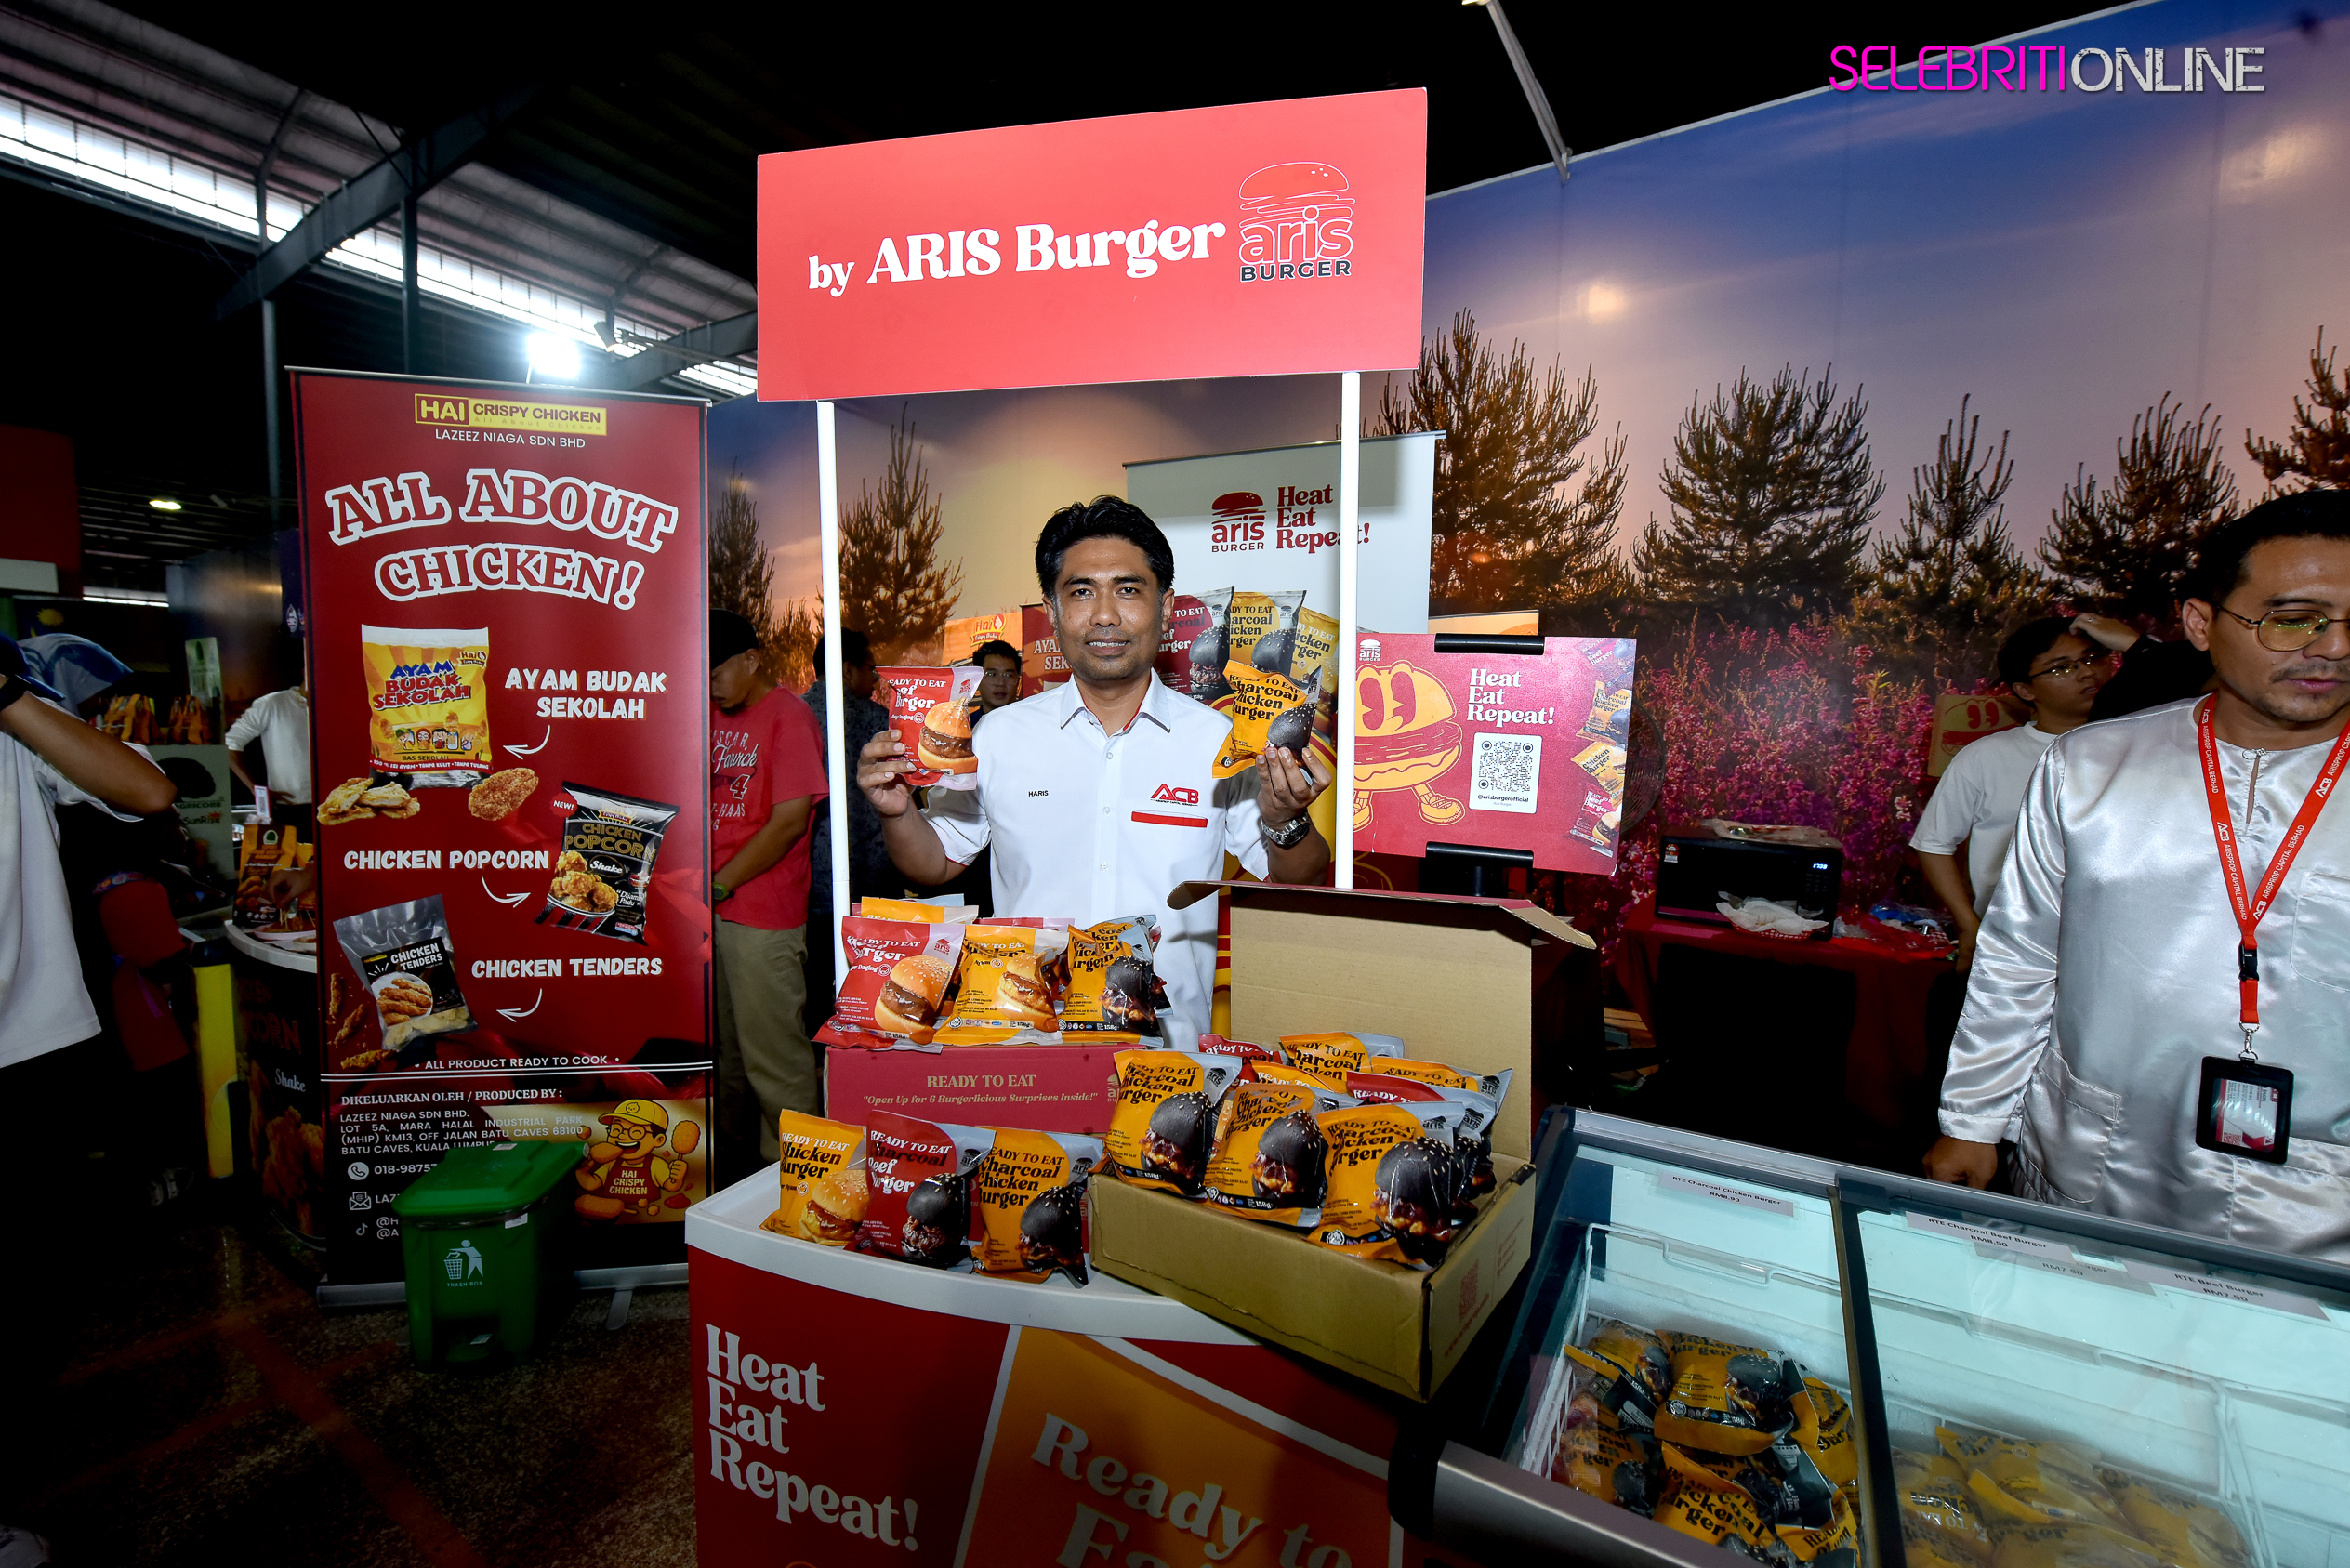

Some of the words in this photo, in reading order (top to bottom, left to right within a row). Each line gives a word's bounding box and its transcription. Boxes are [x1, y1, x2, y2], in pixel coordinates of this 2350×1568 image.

[1238, 205, 1353, 265] aris
[808, 255, 854, 296] by
[865, 228, 1001, 284] ARIS
[1015, 219, 1226, 279] Burger
[1239, 259, 1353, 283] BURGER
[420, 400, 465, 421] HAI
[472, 403, 529, 418] CRISPY
[532, 407, 601, 424] CHICKEN
[435, 428, 480, 442] LAZEEZ
[483, 432, 525, 445] NIAGA
[529, 435, 556, 447] SDN
[560, 438, 586, 448] BHD
[1277, 484, 1333, 507] Heat
[325, 471, 452, 546] ALL
[459, 468, 679, 554] ABOUT
[1277, 507, 1316, 528] Eat
[1212, 515, 1264, 543] aris
[1276, 523, 1370, 554] Repet!
[1212, 542, 1264, 552] BURGER
[375, 543, 645, 611] CHICKEN!
[1189, 607, 1205, 616] EAT
[1034, 639, 1061, 654] AYA
[389, 659, 455, 679] AYAM
[1470, 668, 1521, 687] Heat
[385, 673, 461, 693] BUDAK
[505, 668, 578, 691] AYAM
[587, 671, 667, 693] BUDAK
[1265, 677, 1279, 686] TO
[1281, 680, 1300, 693] EAT
[372, 685, 471, 711] SEKOLAH
[1469, 685, 1505, 705] Eat
[536, 697, 645, 720] SEKOLAH
[1467, 704, 1555, 727] Repeat!
[730, 774, 750, 799] 4
[1028, 789, 1049, 797] HARIS
[1150, 783, 1199, 804] ACB
[2315, 777, 2333, 798] ACB
[553, 800, 574, 810] NEW!
[582, 824, 642, 841] CHICKEN
[2217, 822, 2230, 842] ACB
[564, 834, 656, 863] POPCORN
[2224, 843, 2237, 874] ARISPROP
[344, 850, 441, 869] CHICKEN
[449, 850, 549, 869] POPCORN
[589, 860, 622, 874] Shake
[2252, 900, 2267, 920] ACB
[2262, 871, 2280, 899] ARISPROP
[2276, 848, 2292, 871] CAPITAL
[2288, 824, 2305, 849] BERHAD
[2230, 872, 2242, 899] CAPITAL
[390, 942, 440, 965] CHICKEN
[400, 953, 442, 971] TENDERS
[471, 958, 561, 978] CHICKEN
[569, 957, 662, 976] TENDERS
[425, 1060, 444, 1070] ALL
[448, 1058, 506, 1069] PRODUCT
[510, 1057, 548, 1068] READY
[552, 1057, 569, 1065] TO
[572, 1055, 607, 1064] COOK
[1343, 1050, 1365, 1061] EAT
[927, 1074, 979, 1087] READY
[982, 1075, 1004, 1087] TO
[1008, 1074, 1036, 1087] EAT
[341, 1092, 429, 1105] DIKELUARKAN
[432, 1091, 464, 1101] OLEH
[475, 1088, 538, 1100] PRODUCED
[540, 1088, 557, 1099] BY
[863, 1095, 894, 1105] "Open
[896, 1095, 909, 1106] Up
[911, 1095, 927, 1103] for
[930, 1095, 935, 1103] 6
[937, 1094, 1007, 1104] Burgerlicious
[1009, 1093, 1058, 1103] Surprises
[1060, 1092, 1098, 1102] Inside!"
[340, 1113, 377, 1123] LAZEEZ
[381, 1111, 416, 1120] NIAGA
[419, 1110, 441, 1119] SDN
[444, 1110, 469, 1118] BHD.
[340, 1125, 360, 1133] LOT
[372, 1123, 389, 1132] 5A,
[400, 1122, 431, 1131] MARA
[442, 1120, 474, 1128] HALAL
[485, 1117, 546, 1127] INDUSTRIAL
[555, 1116, 583, 1125] PARK
[341, 1133, 379, 1145] (MHIP)
[385, 1133, 415, 1142] KM13,
[418, 1132, 439, 1140] OFF
[443, 1130, 477, 1140] JALAN
[482, 1129, 509, 1139] BATU
[513, 1127, 548, 1137] CAVES
[552, 1127, 584, 1135] 68100
[782, 1133, 813, 1147] READY
[814, 1139, 827, 1147] TO
[829, 1141, 850, 1152] EAT
[871, 1130, 909, 1147] READY
[928, 1144, 953, 1154] EAT
[341, 1146, 370, 1154] BATU
[374, 1144, 413, 1153] CAVES,
[416, 1142, 450, 1152] KUALA
[868, 1158, 897, 1174] Beef
[981, 1155, 1061, 1179] Charcoal
[1023, 1153, 1039, 1163] TO
[1041, 1155, 1065, 1166] EAT
[614, 1177, 645, 1187] CRISPY
[622, 1169, 638, 1178] HAI
[978, 1171, 1039, 1192] Chicken
[609, 1185, 648, 1195] CHICKEN
[1688, 1179, 1721, 1191] Charcoal
[1723, 1188, 1752, 1198] Chicken
[1754, 1195, 1781, 1205] Burger
[376, 1216, 399, 1228] @H
[376, 1228, 399, 1240] @A
[1928, 1218, 1946, 1226] RTE
[1947, 1222, 1988, 1235] Charcoal
[1990, 1232, 2012, 1241] Beef
[2014, 1236, 2048, 1248] Burger
[2174, 1273, 2196, 1283] RTE
[2198, 1278, 2224, 1288] Beef
[2225, 1285, 2264, 1298] Burger
[706, 1323, 826, 1413] Heat
[707, 1376, 789, 1454] Eat
[708, 1428, 919, 1552] Repeat!
[1030, 1412, 1265, 1561] Ready
